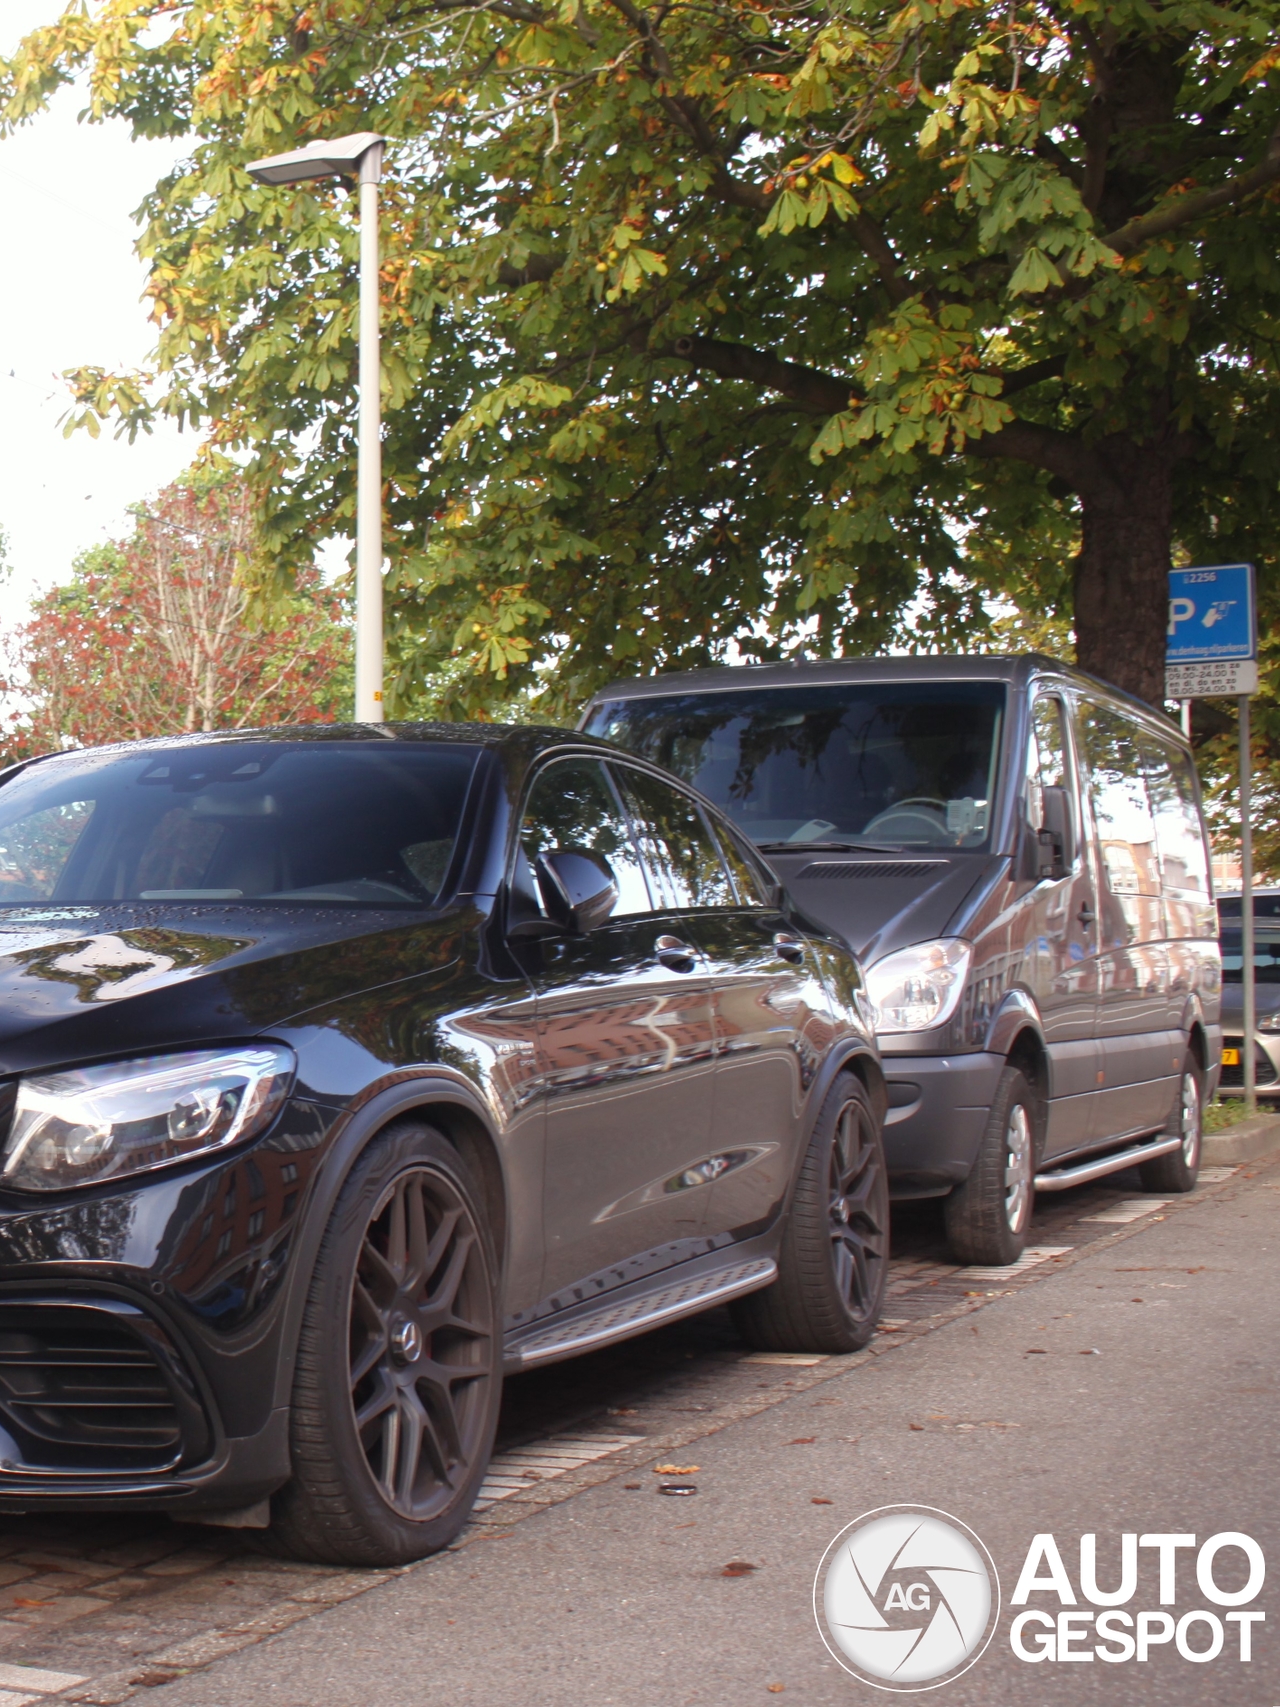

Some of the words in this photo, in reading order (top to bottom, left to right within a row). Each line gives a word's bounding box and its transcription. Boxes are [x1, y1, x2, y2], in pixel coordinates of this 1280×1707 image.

[1189, 572, 1216, 583] 2256
[1167, 598, 1196, 635] P
[1168, 670, 1227, 680] 09.00-24.00
[1169, 685, 1227, 695] 18.00-24.00
